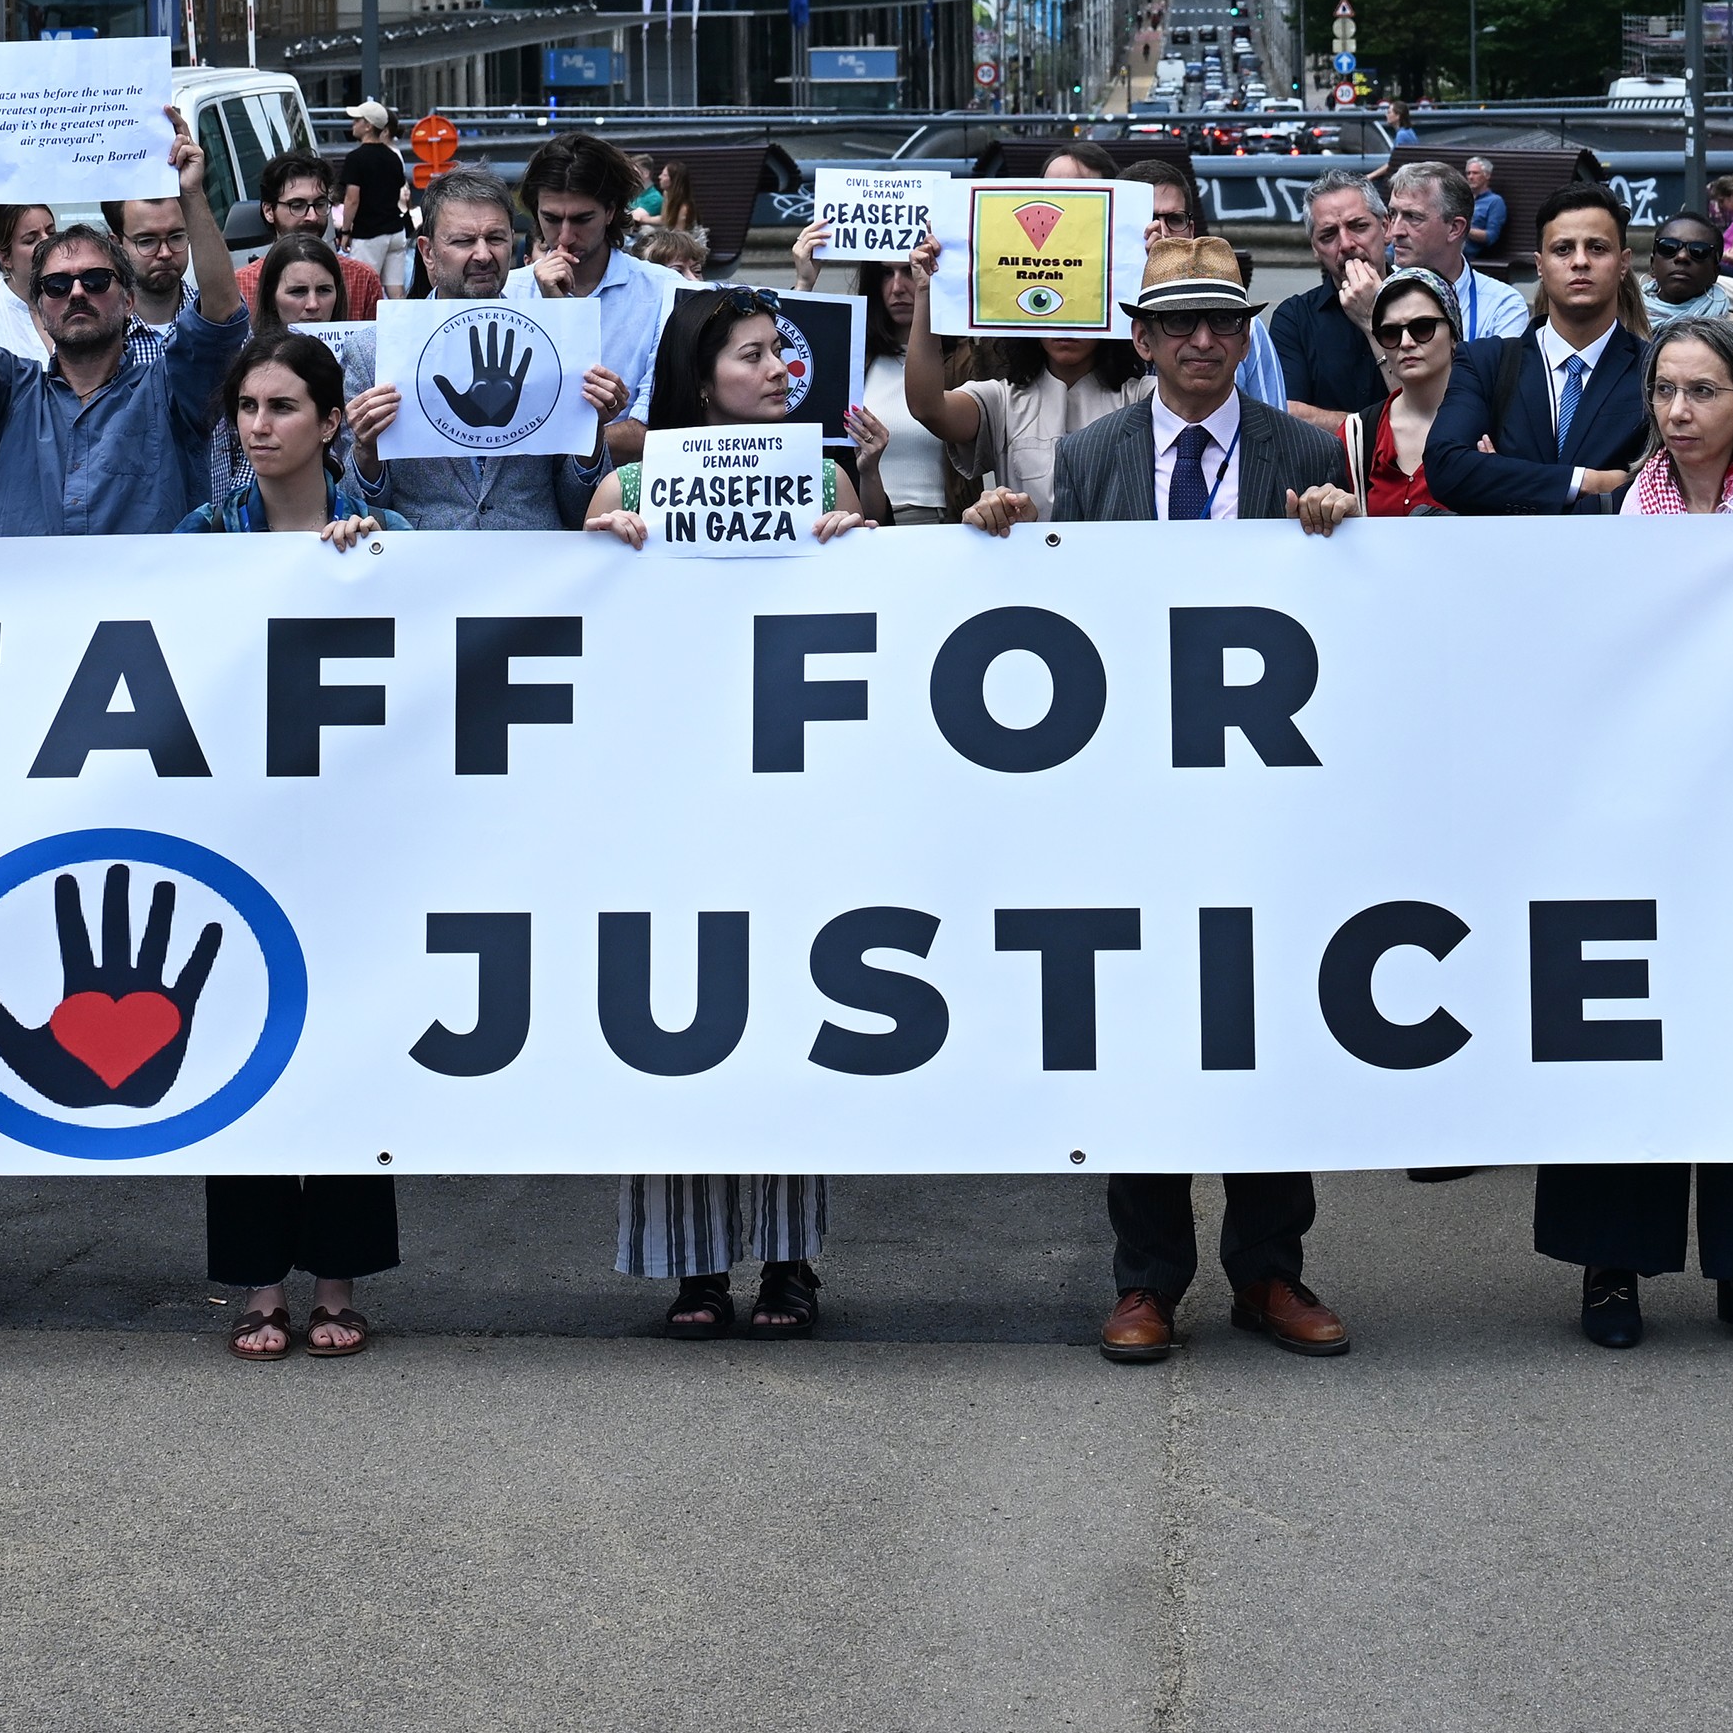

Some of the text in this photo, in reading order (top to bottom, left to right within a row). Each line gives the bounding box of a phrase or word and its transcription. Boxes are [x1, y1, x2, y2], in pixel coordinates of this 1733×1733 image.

[20, 91, 40, 99] was
[43, 88, 79, 101] before
[81, 86, 99, 98] the
[102, 87, 124, 96] war
[126, 85, 143, 95] the
[40, 103, 88, 116] open-air
[90, 102, 129, 114] prison.
[40, 119, 58, 130] the
[60, 119, 104, 132] greatest
[107, 117, 139, 130] open-
[20, 136, 36, 146] air
[72, 150, 147, 164] Josep Borrell
[846, 177, 922, 189] CIVIL SERVANTS
[862, 190, 905, 200] DEMAND
[823, 203, 930, 226] CEASEFIR
[834, 228, 926, 251] IN GAZA
[998, 256, 1083, 269] All Eyes on
[1016, 269, 1064, 280] Rafah
[443, 312, 537, 335] CIVIL SERVANTS
[318, 331, 342, 342] CIVIL
[780, 322, 810, 360] RAFAH
[791, 379, 808, 403] ALL
[435, 415, 544, 444] AGAINST GENOCIDE
[682, 437, 783, 452] CIVIL SERVANTS
[703, 455, 759, 468] DEMAND
[650, 475, 814, 507] CEASEFIRE
[665, 511, 797, 543] IN GAZA
[753, 606, 1323, 773] FOR
[409, 900, 1663, 1077] JUSTICE
